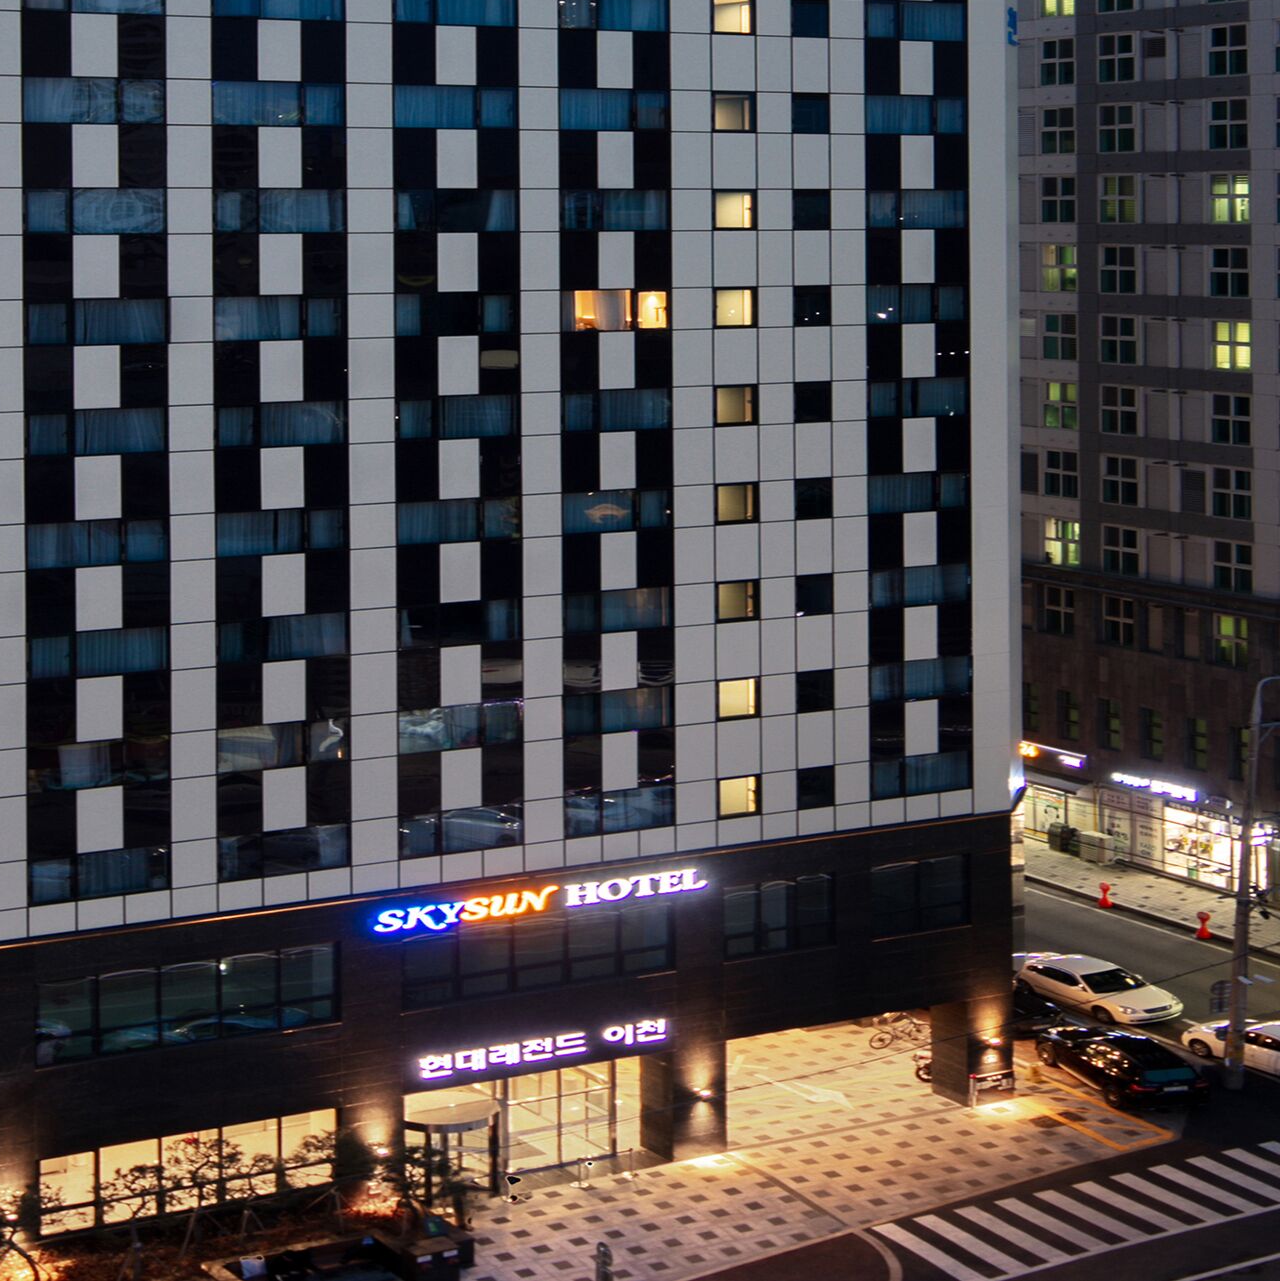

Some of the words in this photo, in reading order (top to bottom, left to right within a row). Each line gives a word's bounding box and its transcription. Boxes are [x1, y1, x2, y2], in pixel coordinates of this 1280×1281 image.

[373, 884, 561, 933] SKYSUN
[564, 869, 708, 907] HOTEL
[419, 1032, 587, 1079] 현대레전드
[603, 1019, 667, 1045] 이천
